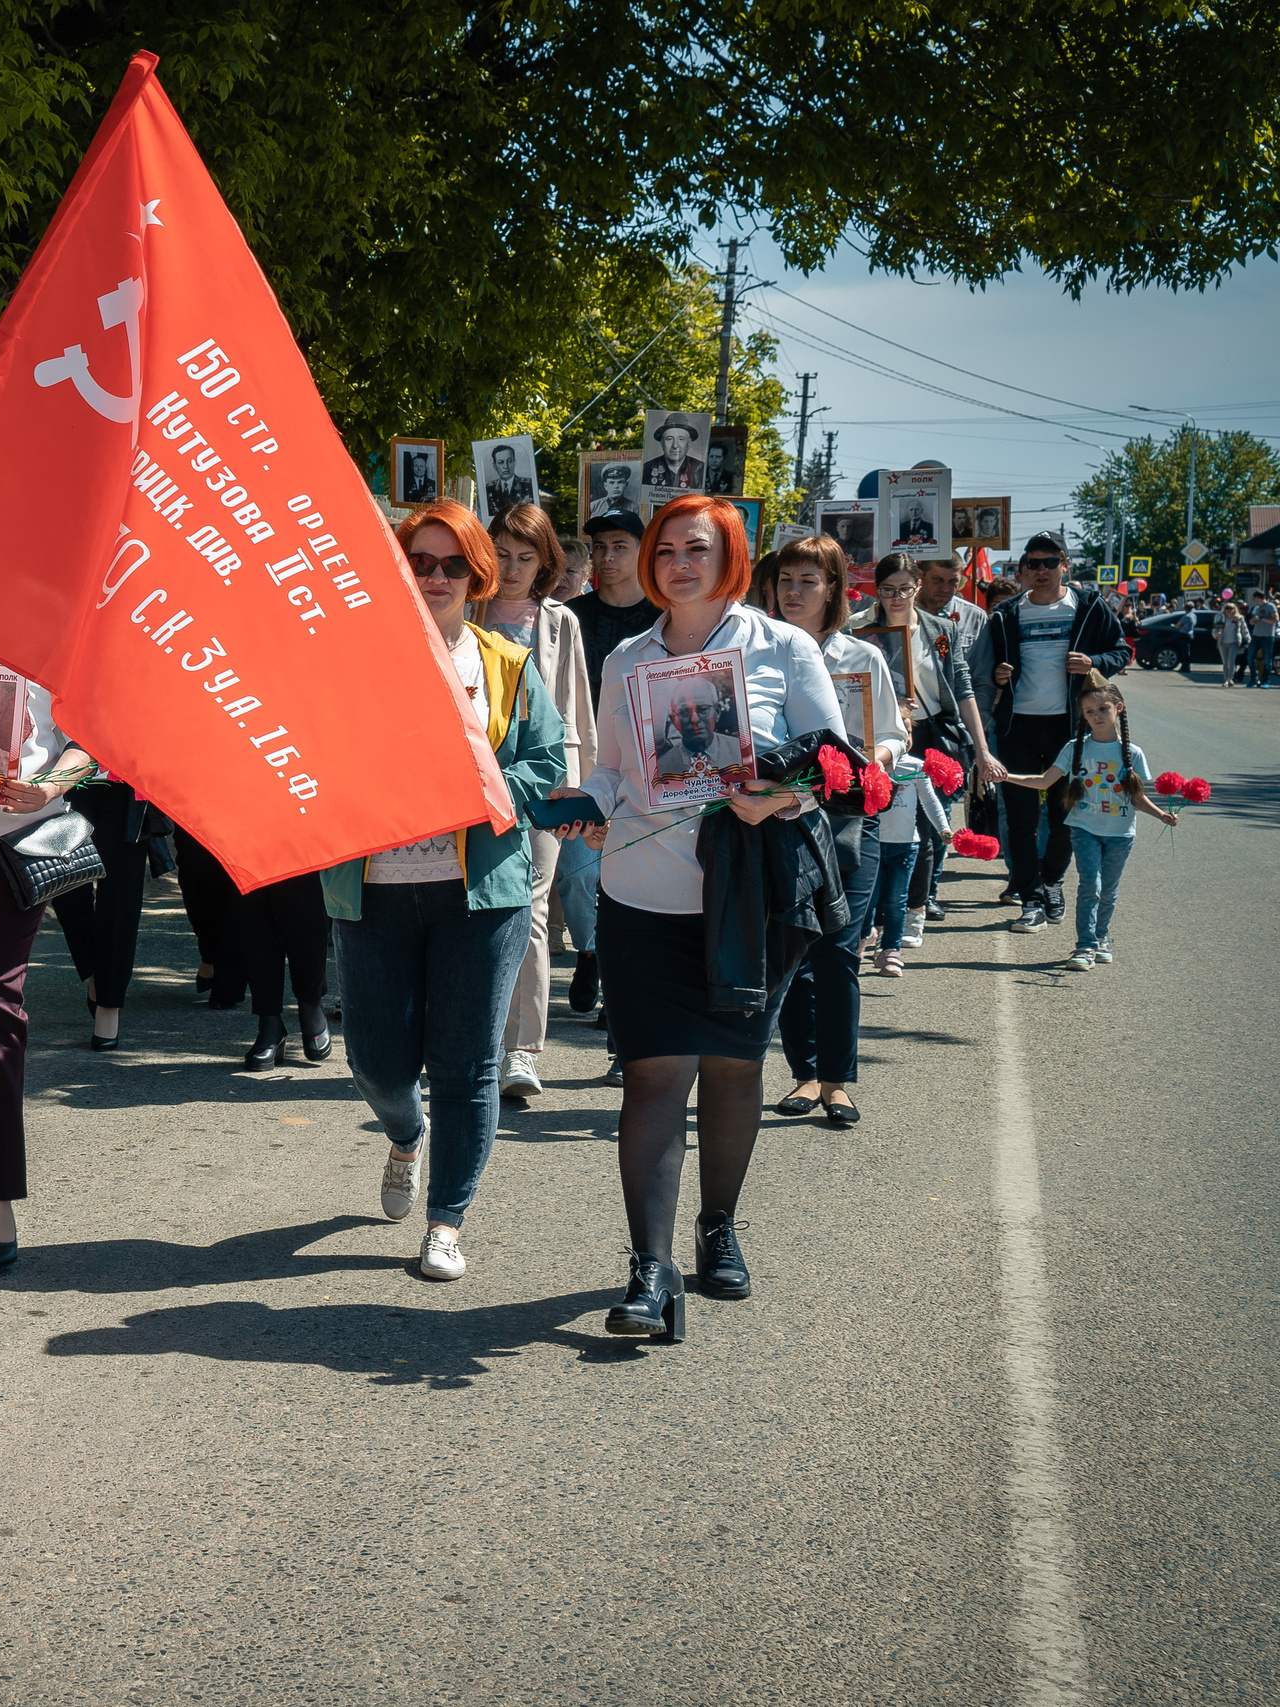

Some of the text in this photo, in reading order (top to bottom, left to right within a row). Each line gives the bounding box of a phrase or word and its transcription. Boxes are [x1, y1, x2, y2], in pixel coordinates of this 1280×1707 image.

[176, 337, 241, 399] 150
[287, 494, 372, 610] ОРДЕНА
[711, 660, 733, 669] ПОЛК
[0, 673, 18, 681] ПОЛК
[684, 775, 720, 787] Чудный
[662, 787, 699, 799] Дорофей
